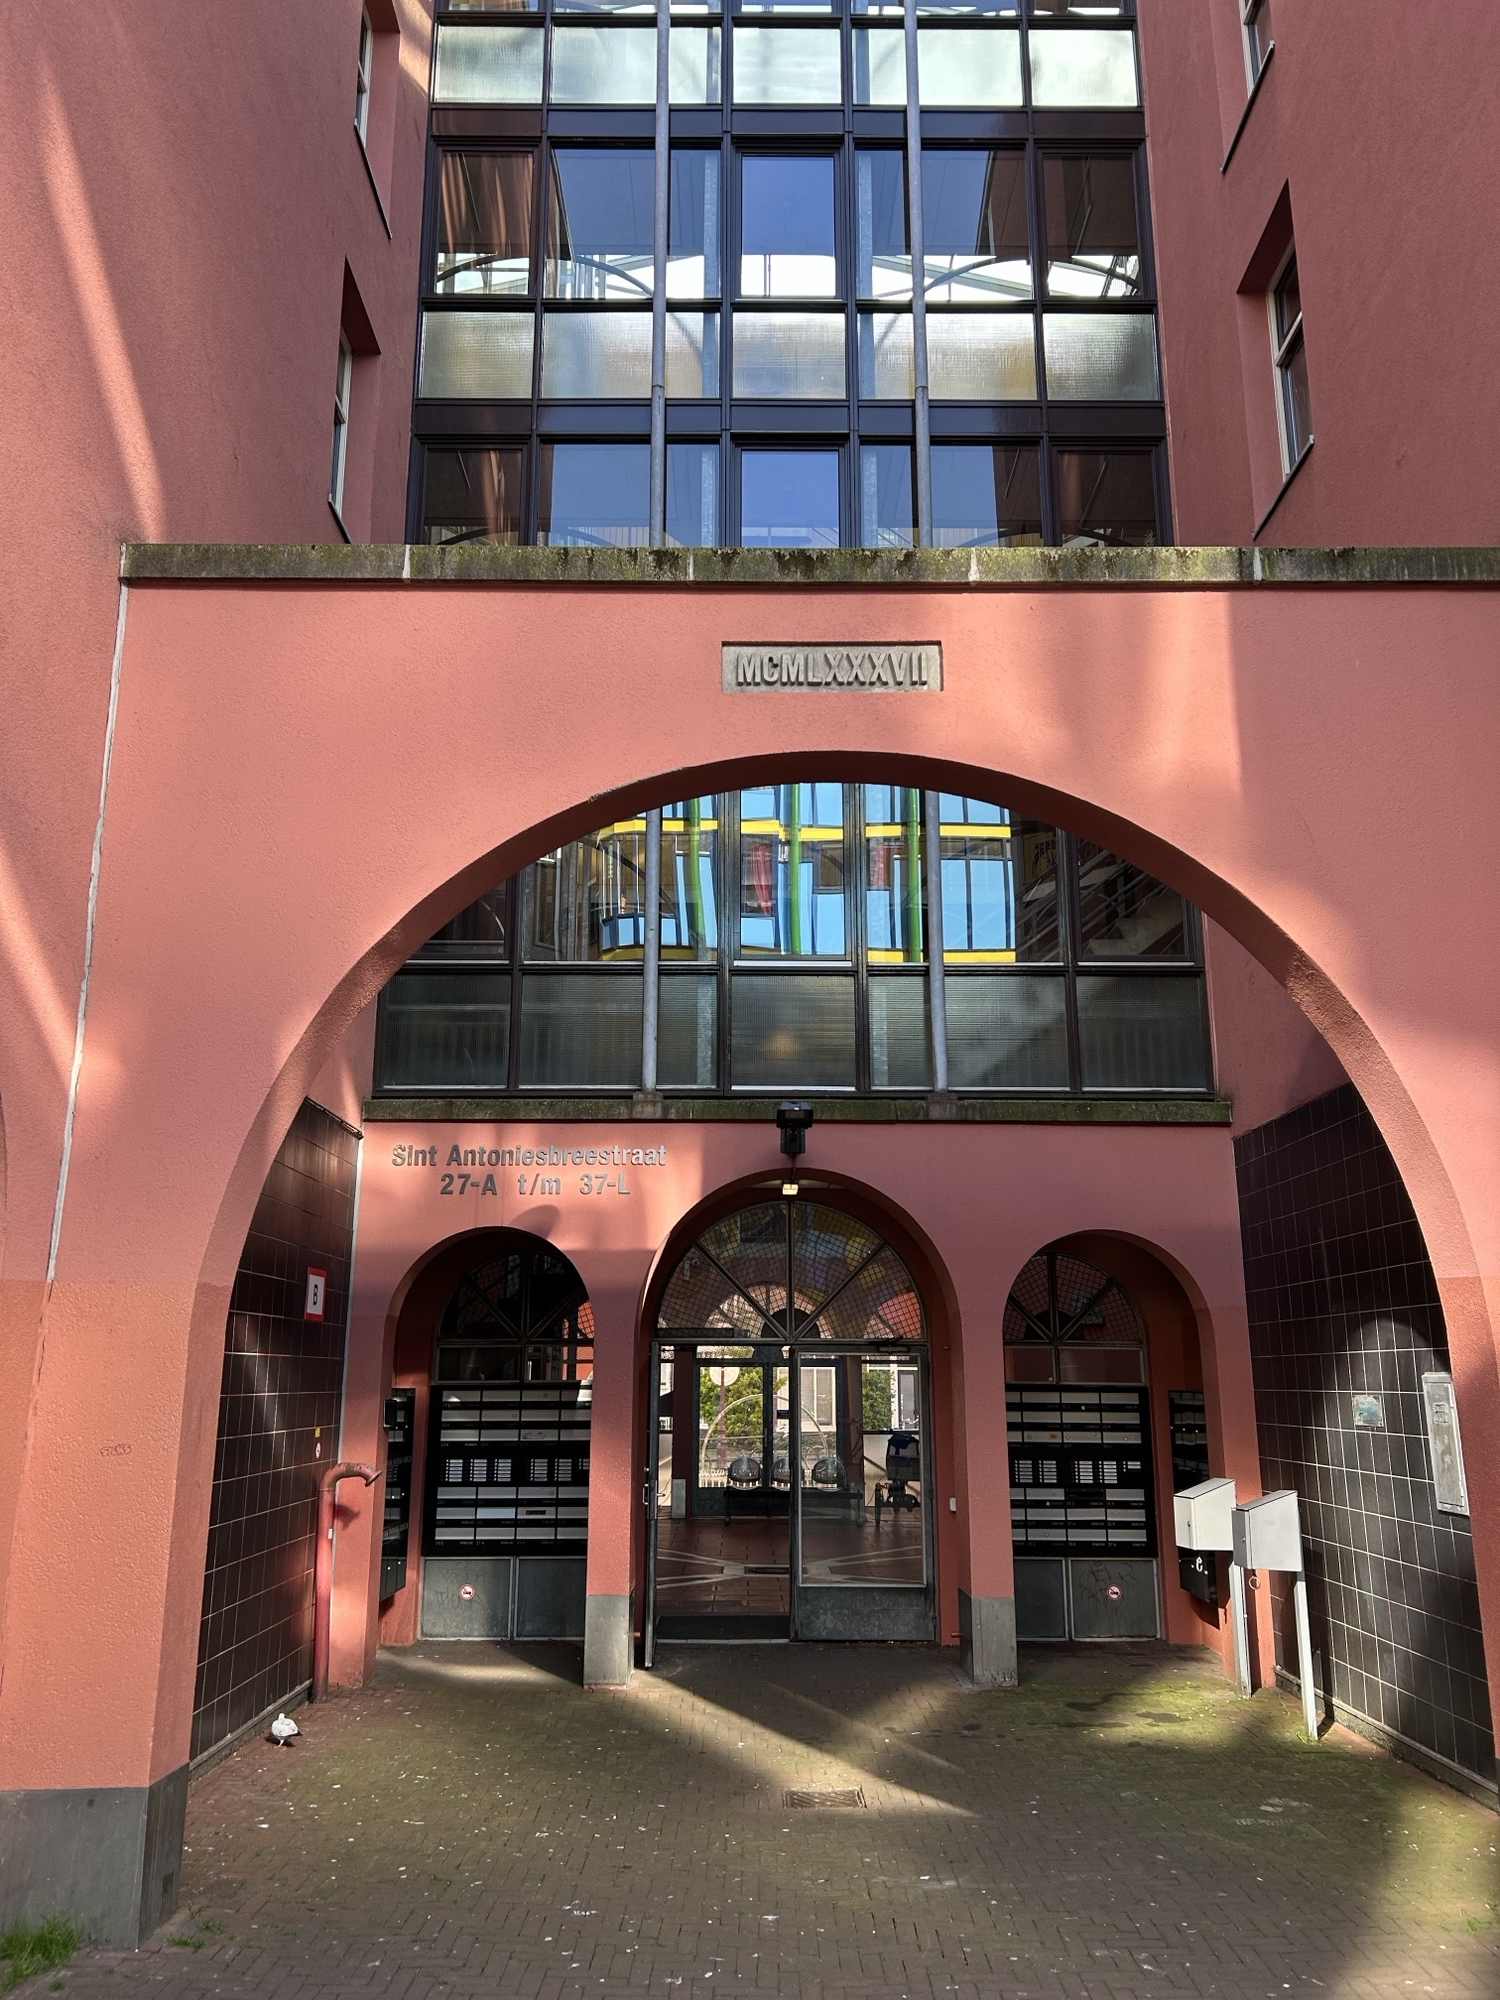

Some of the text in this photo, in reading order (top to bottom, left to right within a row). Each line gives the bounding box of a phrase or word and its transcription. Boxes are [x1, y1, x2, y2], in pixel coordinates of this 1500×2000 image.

[735, 651, 928, 686] MCMLXXXVII
[391, 1144, 668, 1167] Sint Antoniesbreestraat
[439, 1172, 632, 1196] 27-A t/m 37-L
